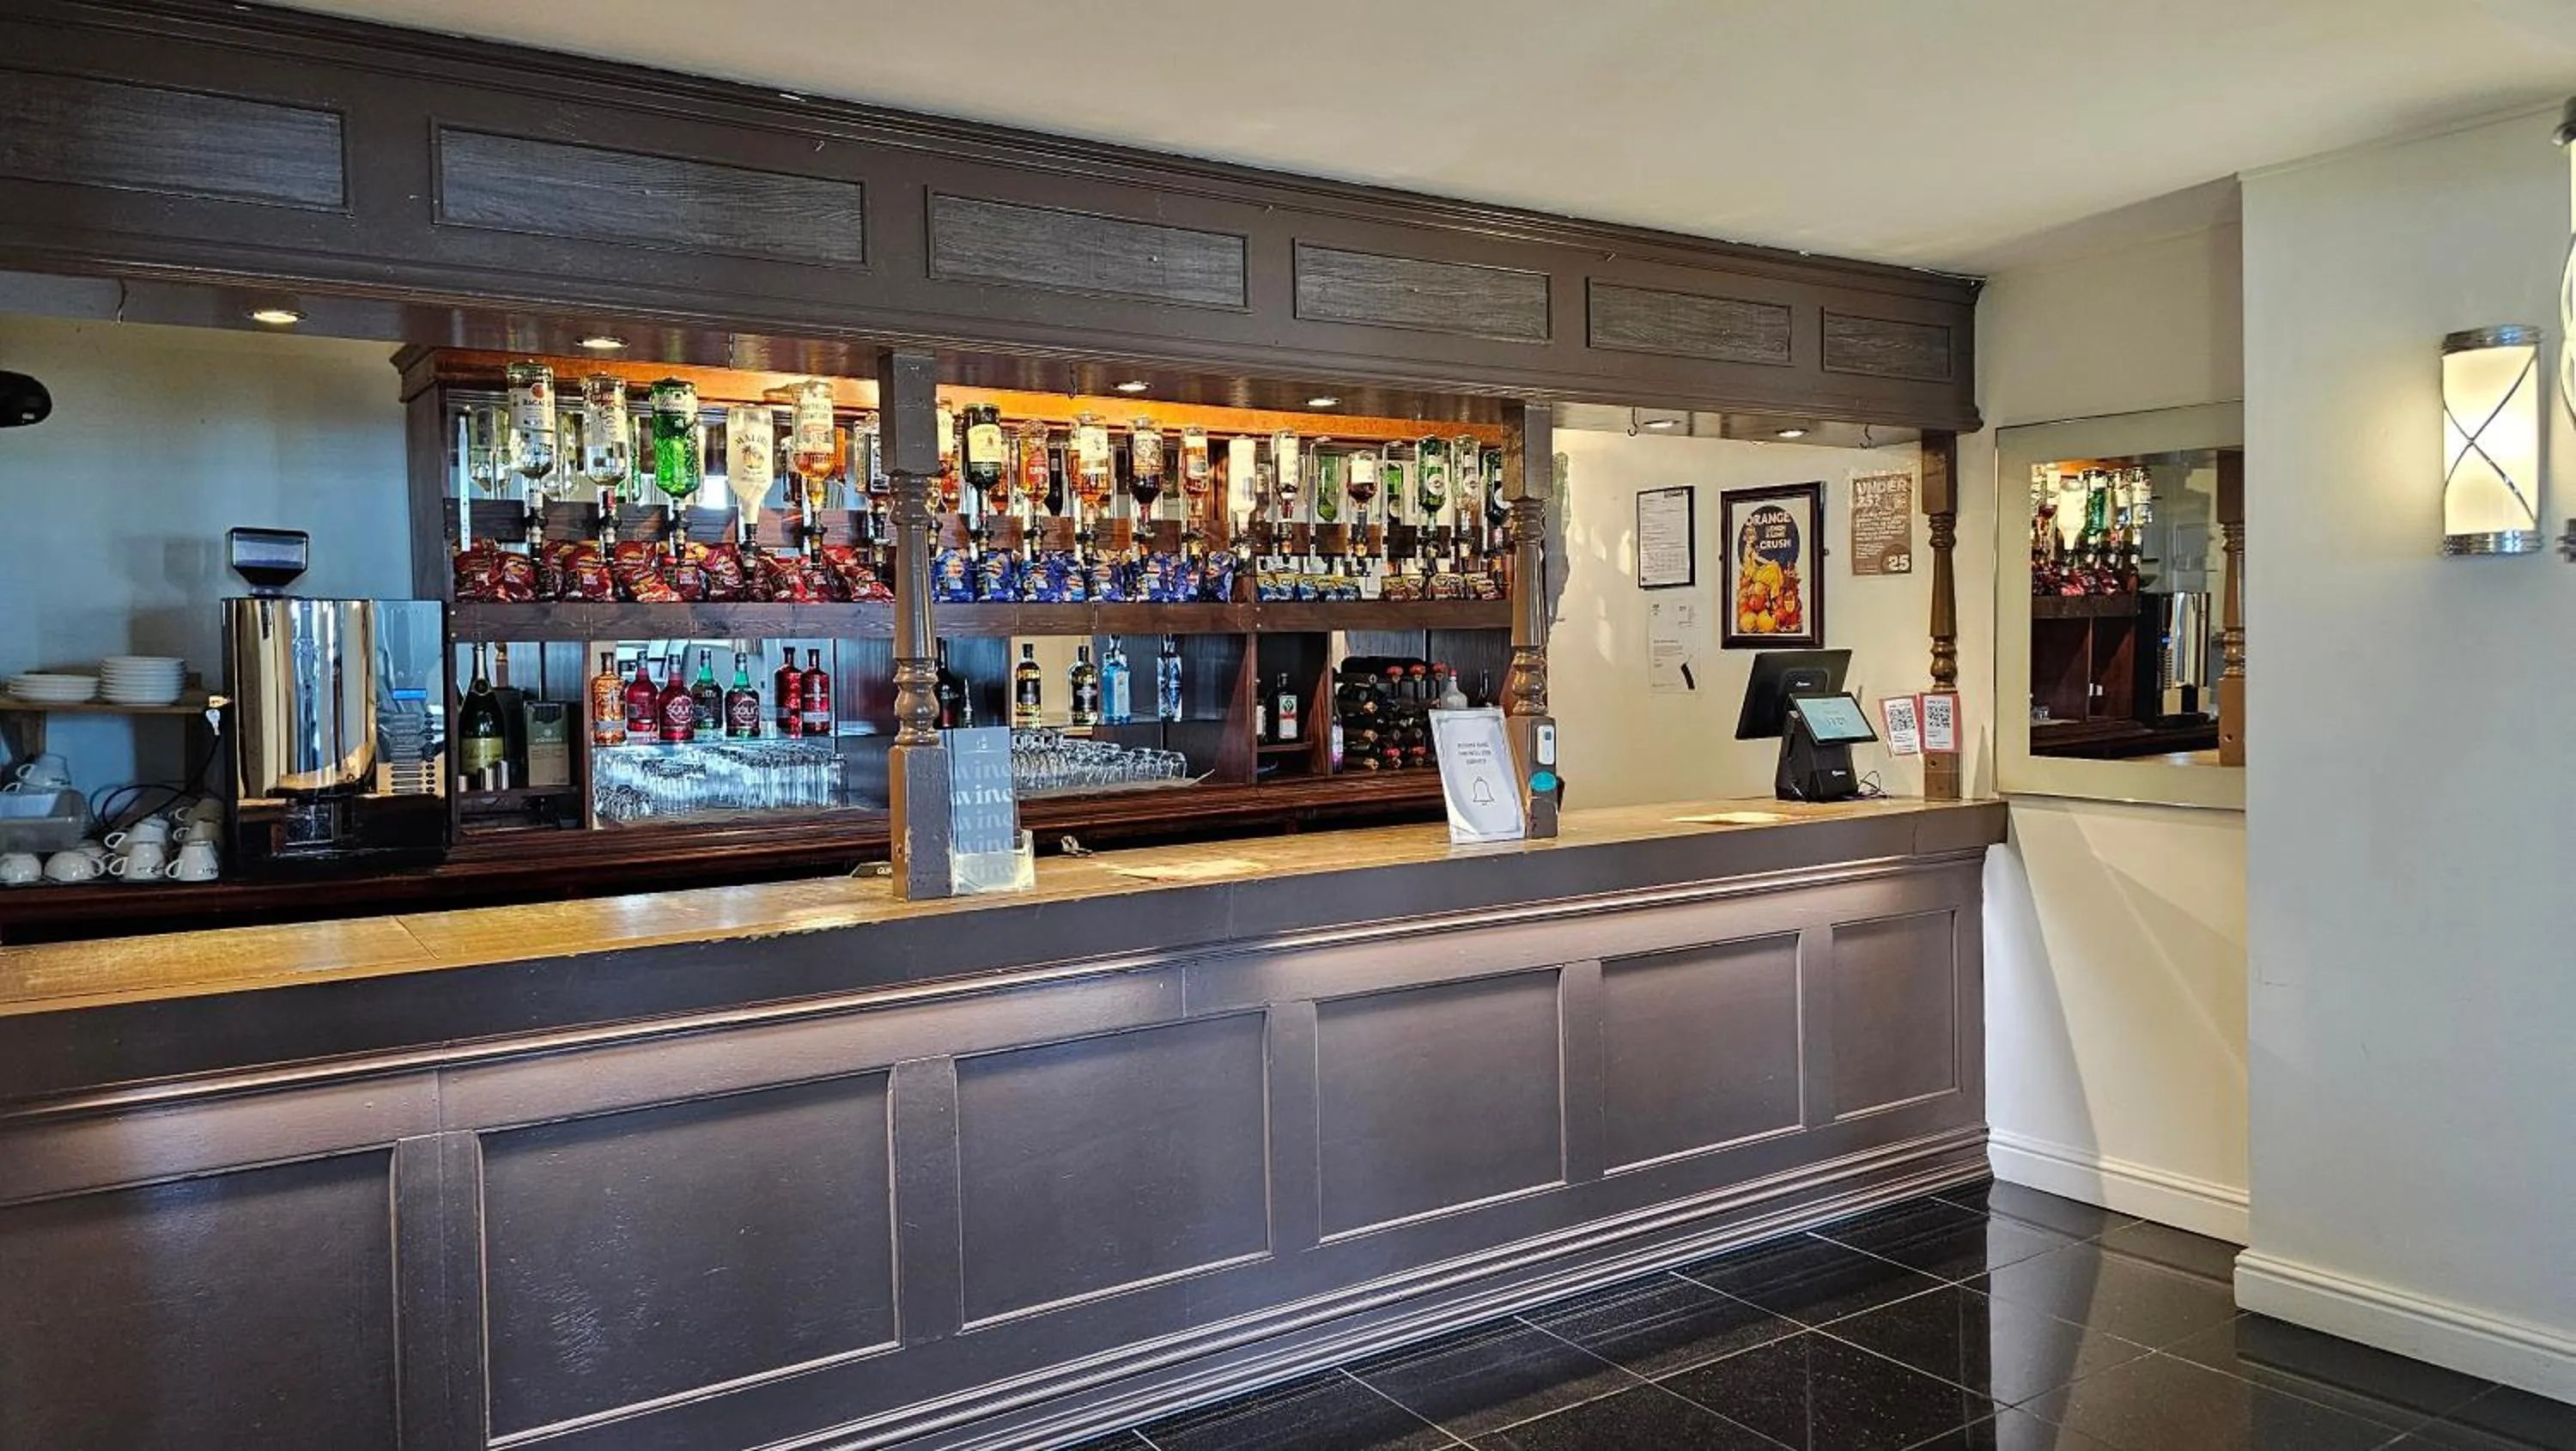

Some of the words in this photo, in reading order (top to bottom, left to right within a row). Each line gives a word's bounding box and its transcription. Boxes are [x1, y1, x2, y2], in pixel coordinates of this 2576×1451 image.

[1856, 479, 1908, 495] UNDER
[1746, 511, 1791, 525] ORANGE
[1759, 538, 1792, 549] CRUSH
[1888, 554, 1911, 571] 25
[951, 784, 1012, 805] wine
